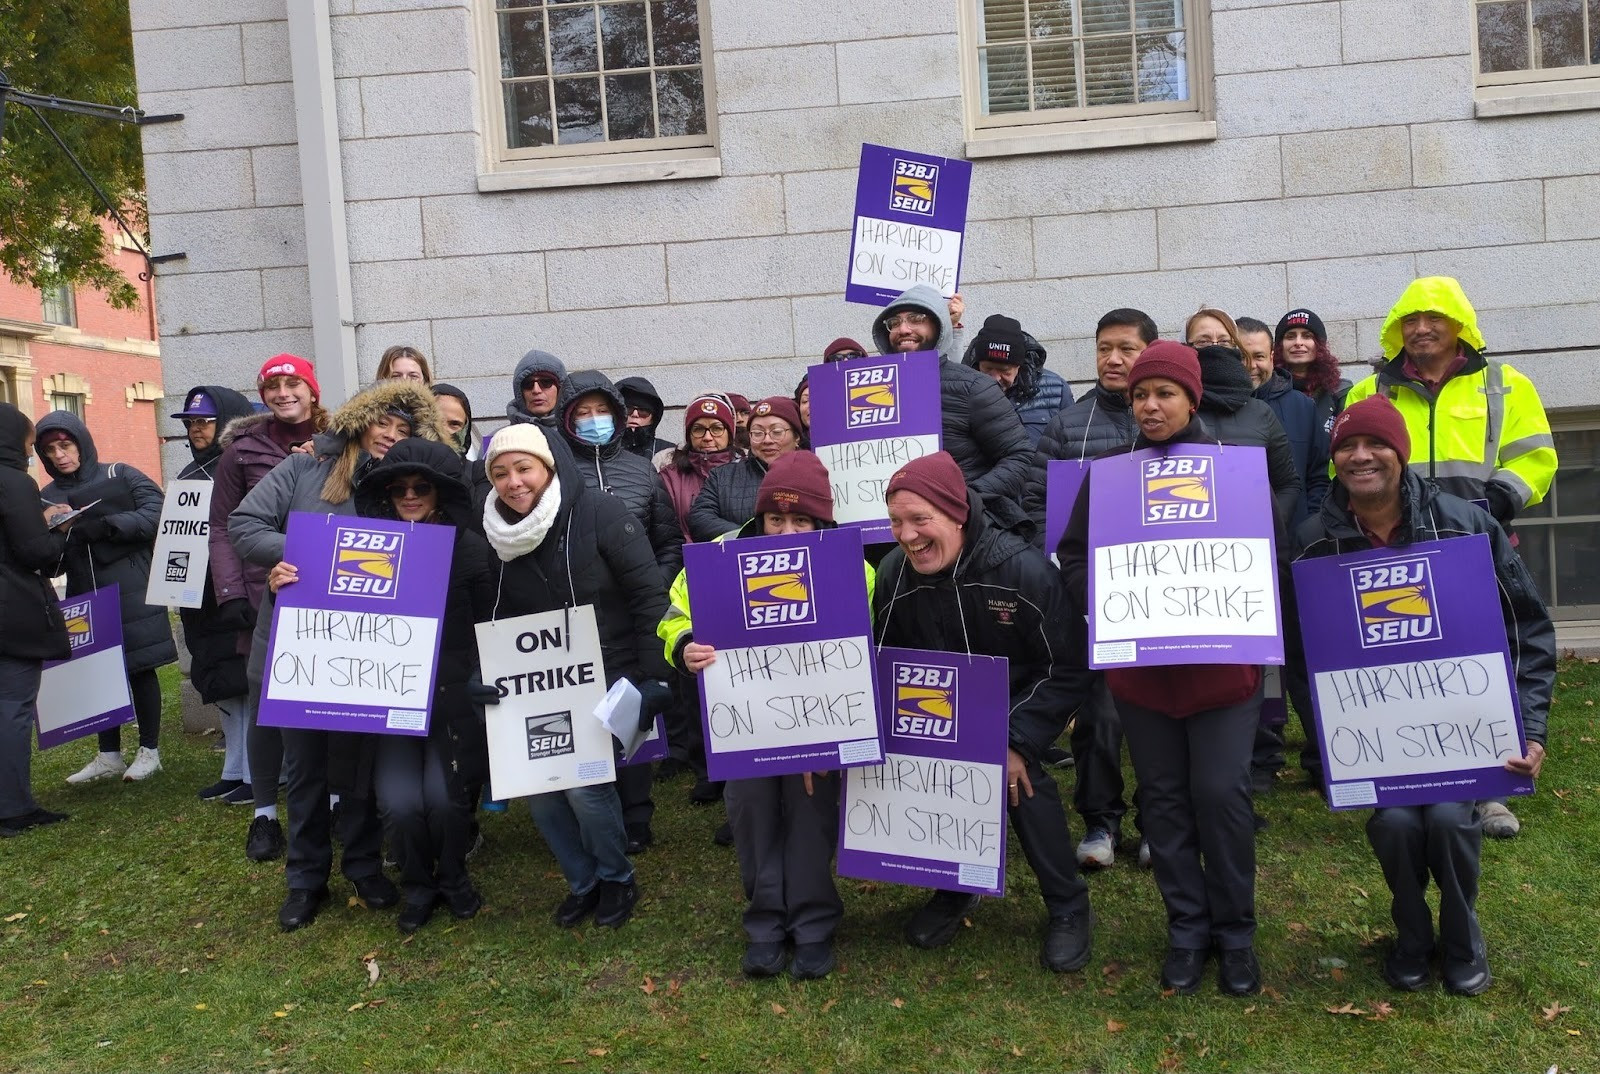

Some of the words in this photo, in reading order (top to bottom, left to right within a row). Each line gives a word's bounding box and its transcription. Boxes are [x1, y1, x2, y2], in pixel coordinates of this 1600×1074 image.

[896, 161, 936, 181] 32BJ
[892, 195, 932, 213] SEIU
[861, 218, 943, 254] HARVARD
[855, 251, 884, 275] ON
[892, 258, 954, 289] STRIKE
[1287, 311, 1310, 320] UNITE
[1287, 317, 1309, 325] HERE!
[988, 350, 1010, 360] HERE!
[989, 342, 1011, 352] UNITE
[848, 367, 895, 387] 32BJ
[850, 406, 896, 426] SEIU
[830, 437, 924, 471] HARVARD
[1145, 459, 1208, 478] 32BJ
[177, 491, 201, 507] ON
[1147, 502, 1210, 522] SEIU
[162, 519, 211, 536] STRIKE
[339, 531, 400, 551] 32BJ
[743, 551, 805, 575] 32BJ
[1107, 540, 1253, 580] HARVARD
[166, 567, 187, 577] SEIU
[1356, 562, 1424, 591] 32BJ
[333, 576, 393, 594] SEIU
[63, 602, 89, 620] 2BJ
[749, 601, 810, 625] SEIU
[988, 599, 1018, 608] HARVARD
[1103, 586, 1150, 623] ON
[1163, 585, 1264, 622] STRIKE
[295, 608, 412, 647] HARVARD
[1366, 616, 1433, 643] SEIU
[515, 626, 562, 653] ON
[273, 651, 317, 686] ON
[327, 656, 422, 696] STRIKE
[724, 639, 863, 688] HARVARD
[494, 662, 595, 698] STRIKE
[896, 666, 954, 687] 32BJ
[1330, 658, 1490, 713] HARVARD
[710, 701, 754, 738] ON
[766, 691, 866, 730] STRIKE
[896, 716, 953, 737] SEIU
[530, 734, 571, 752] SEIU
[530, 750, 551, 758] Stronger
[551, 746, 572, 755] Together
[1331, 726, 1384, 767] ON
[1396, 718, 1513, 760] STRIKE
[860, 756, 992, 805] HARVARD
[847, 799, 891, 837] ON
[905, 807, 999, 856] STRIKE
